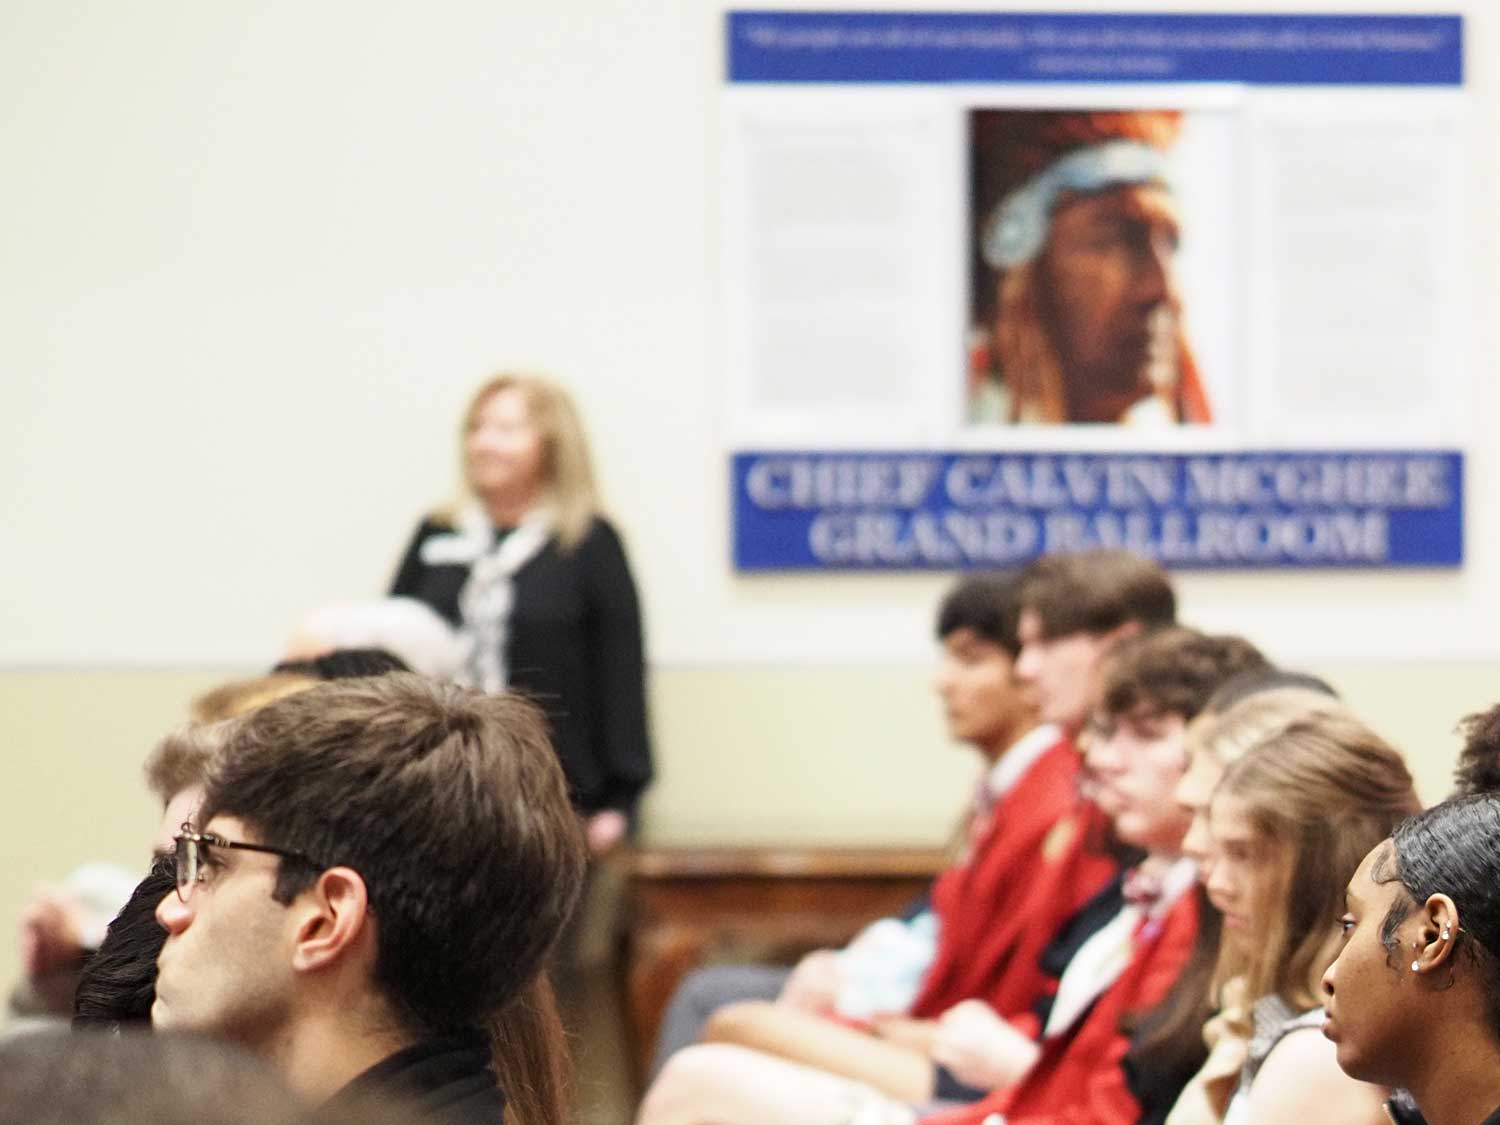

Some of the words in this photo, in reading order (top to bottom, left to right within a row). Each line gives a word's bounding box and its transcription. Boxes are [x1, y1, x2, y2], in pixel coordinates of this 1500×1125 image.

[746, 458, 933, 508] CHIEF
[944, 458, 1174, 507] CALVIN
[808, 510, 1039, 562] GRAND
[1045, 511, 1388, 561] BALLROOM
